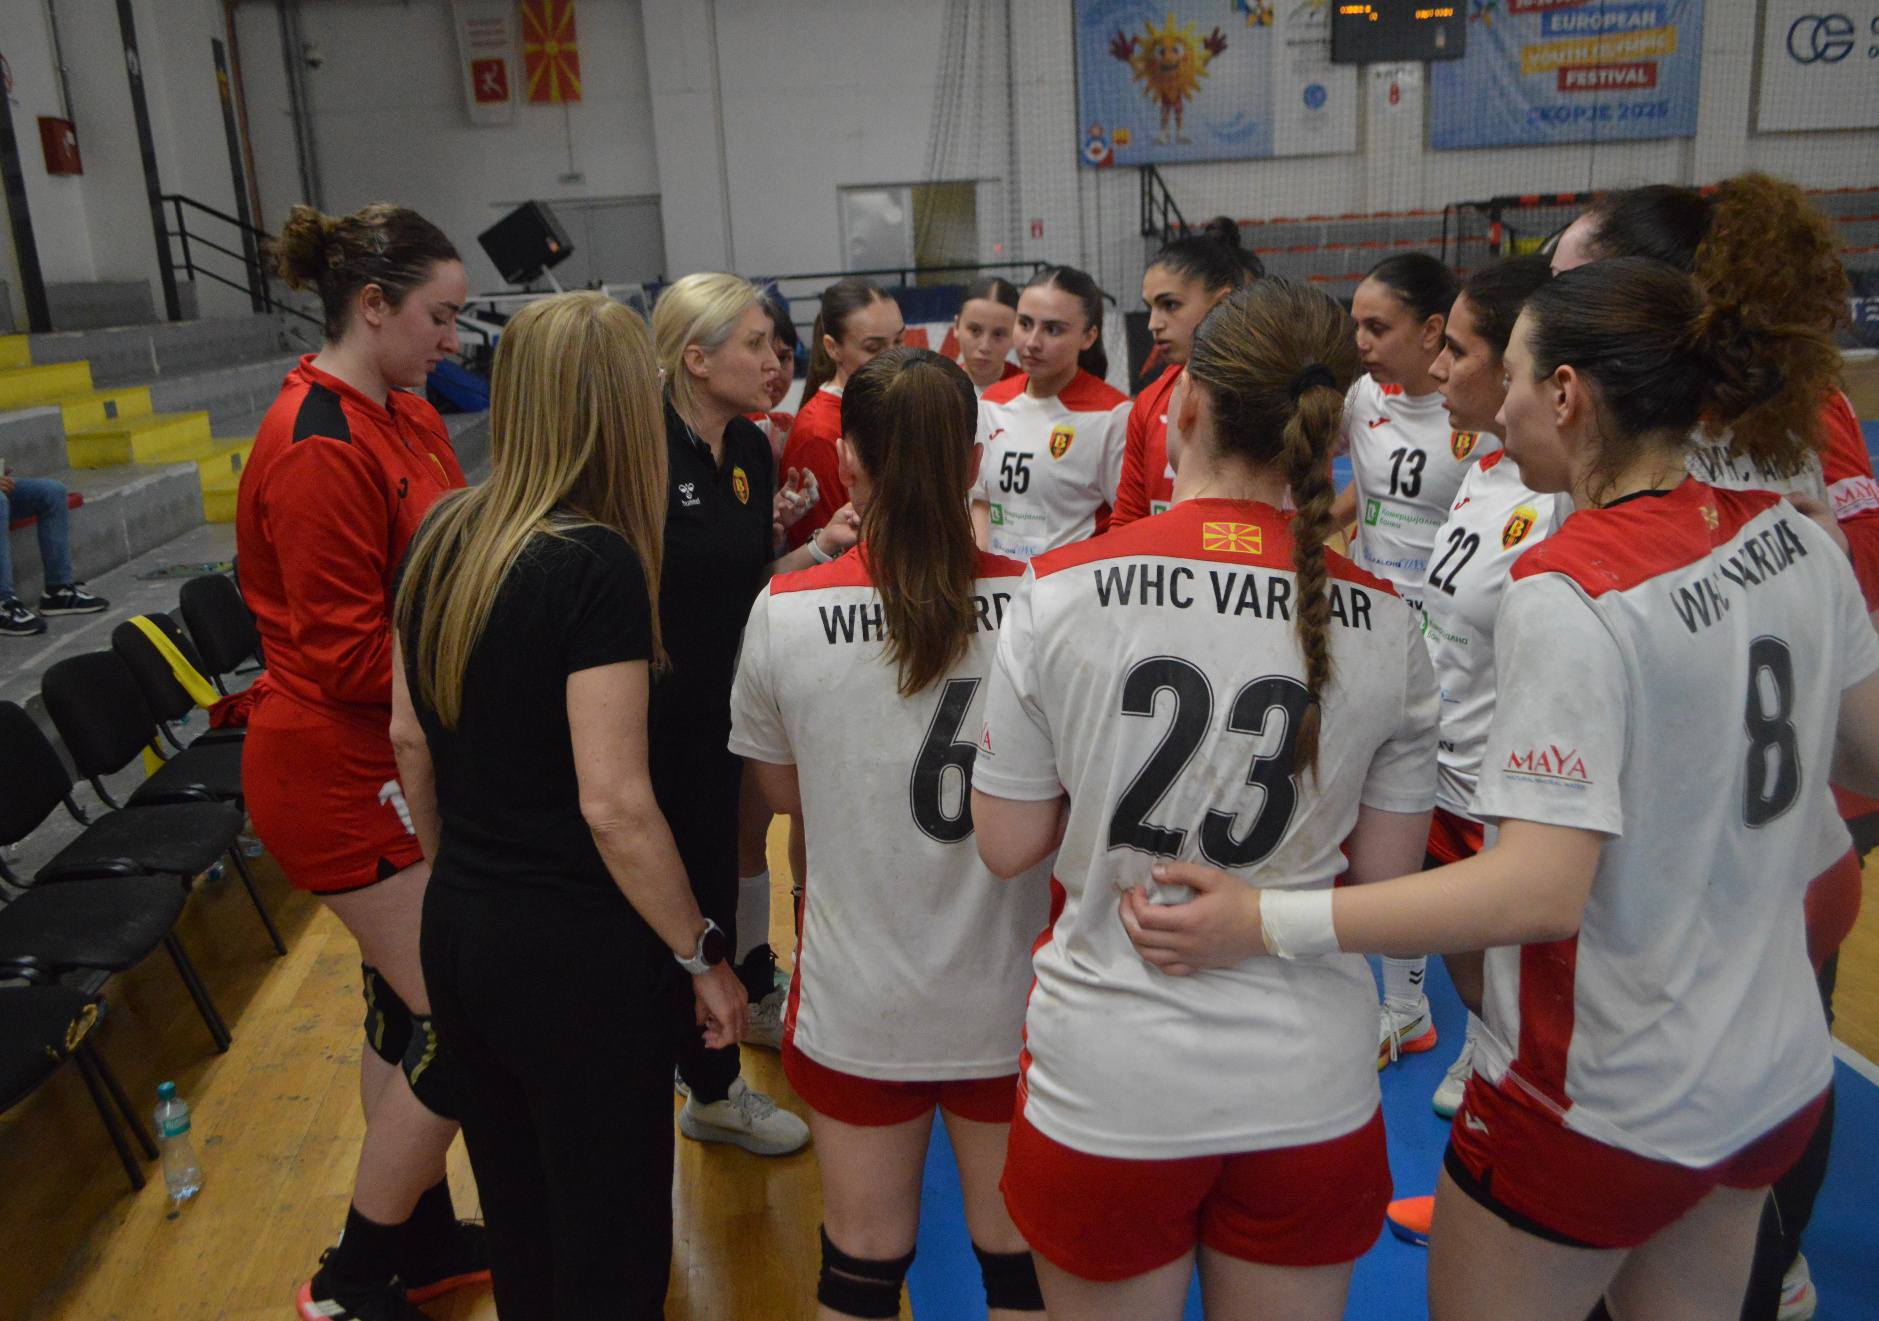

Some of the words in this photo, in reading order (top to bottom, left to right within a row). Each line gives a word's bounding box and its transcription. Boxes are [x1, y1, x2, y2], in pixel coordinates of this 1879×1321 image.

[1551, 10, 1657, 31] EUROPEAN
[1566, 67, 1648, 87] FESTIVAL
[999, 450, 1034, 495] 55
[1388, 447, 1427, 498] 13
[1428, 526, 1480, 598] 22
[818, 602, 888, 645] WH
[1094, 564, 1195, 610] WHC
[1208, 570, 1372, 632] VARAR
[1743, 634, 1802, 829] 8
[909, 677, 983, 844] 6
[1107, 655, 1322, 869] 23
[1507, 744, 1587, 779] MAYA
